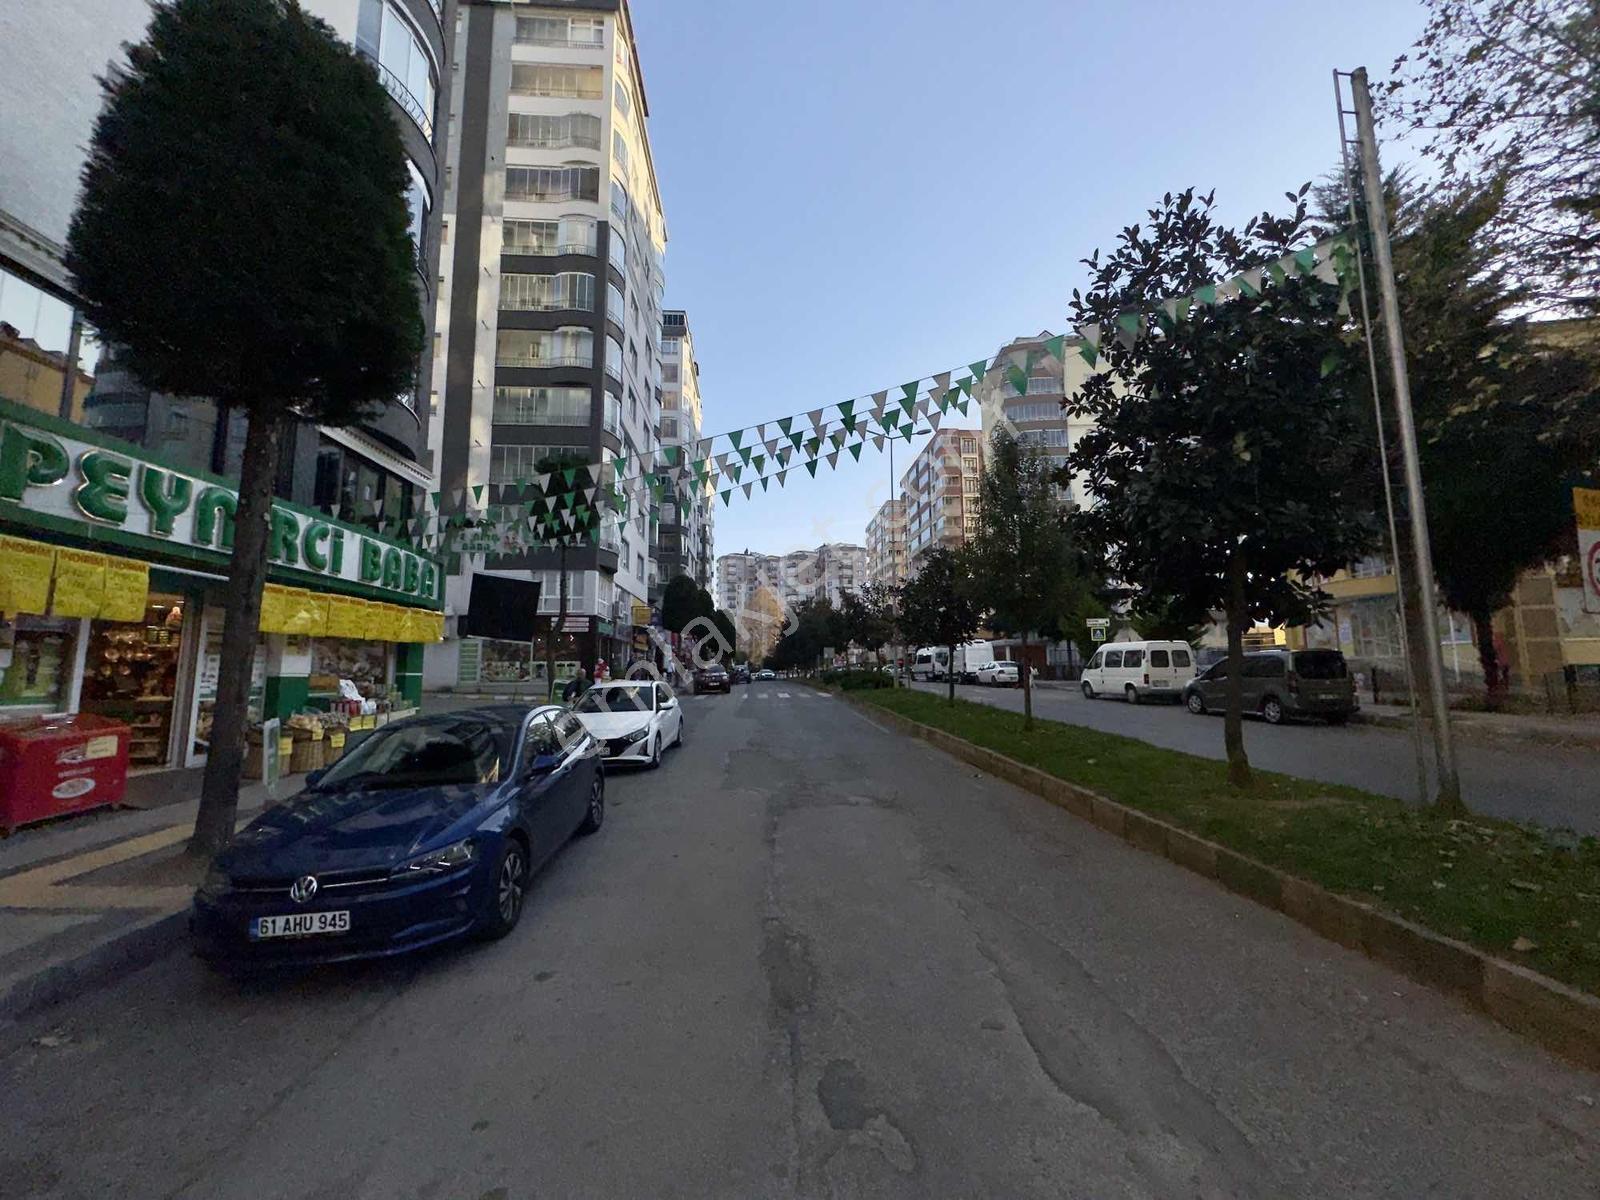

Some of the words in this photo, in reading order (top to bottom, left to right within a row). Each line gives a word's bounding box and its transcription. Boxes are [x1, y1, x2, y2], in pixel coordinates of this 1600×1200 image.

[0, 420, 344, 576] PEYNRCİ
[359, 536, 435, 599] BABA
[260, 918, 277, 935] 61
[283, 915, 313, 933] AHU
[318, 912, 348, 931] 945
